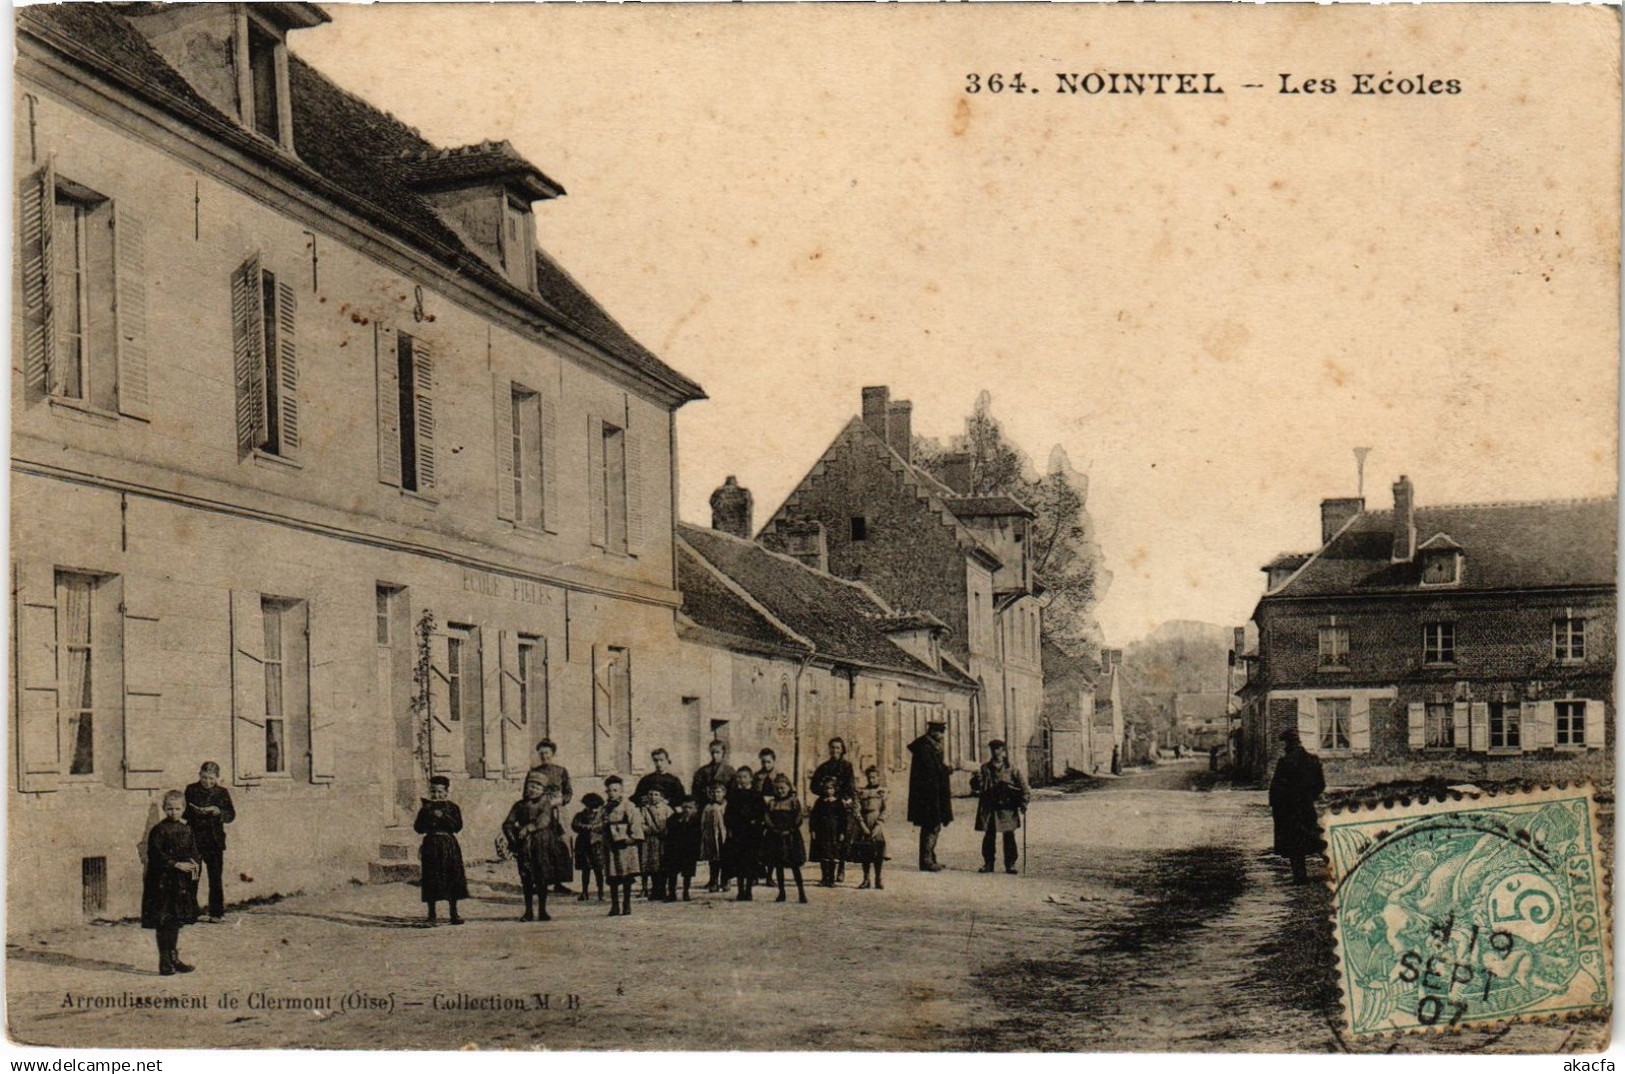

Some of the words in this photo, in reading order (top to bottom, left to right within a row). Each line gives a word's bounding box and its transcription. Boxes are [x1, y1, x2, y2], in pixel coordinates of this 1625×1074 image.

[1569, 857, 1598, 947] POSTES
[1399, 951, 1498, 1001] SEPT
[1417, 995, 1468, 1025] 07
